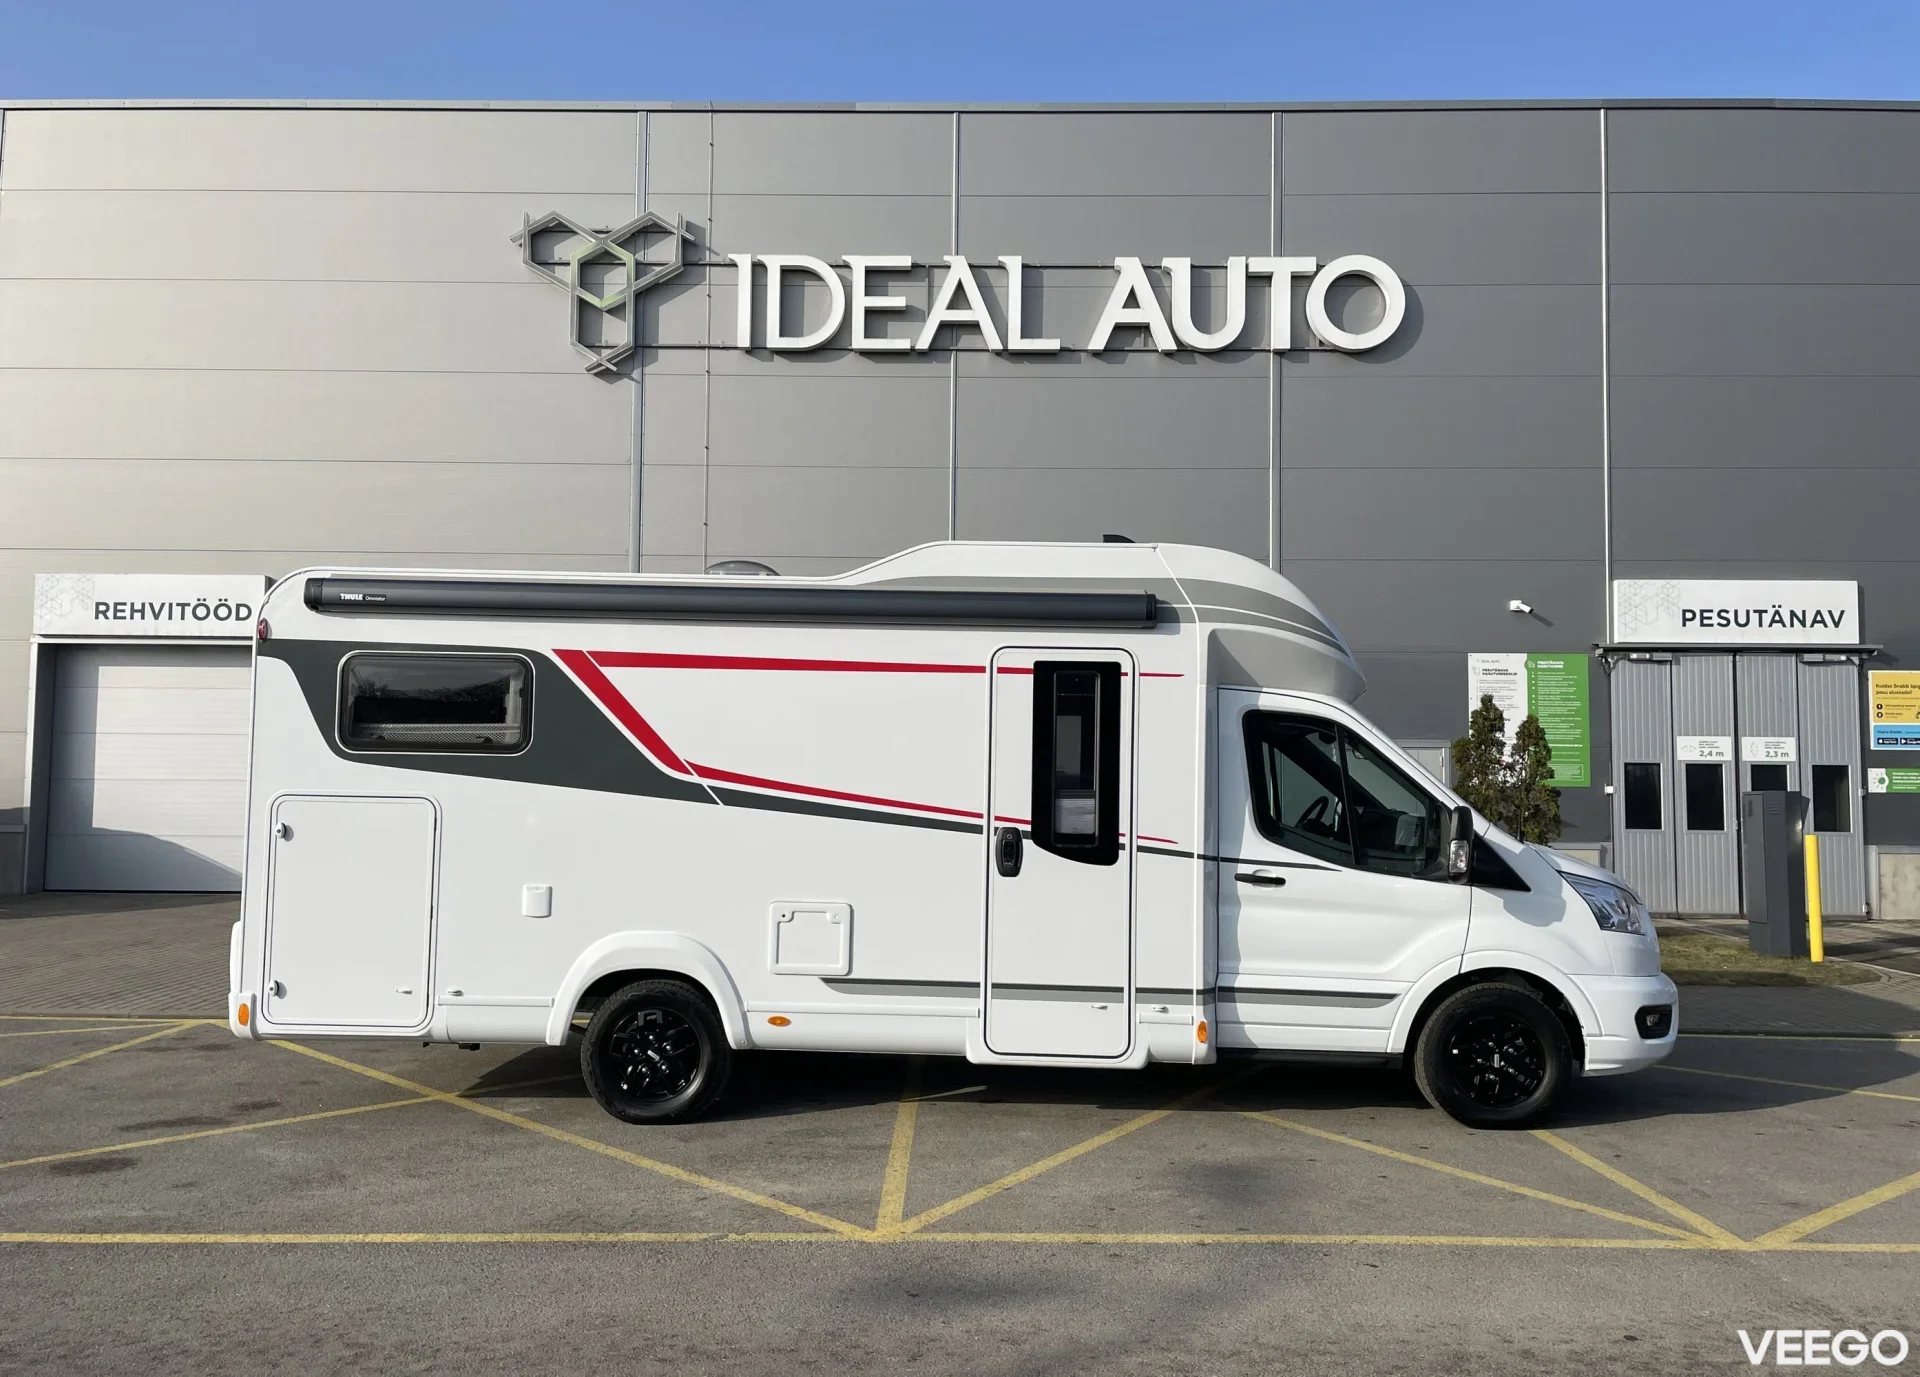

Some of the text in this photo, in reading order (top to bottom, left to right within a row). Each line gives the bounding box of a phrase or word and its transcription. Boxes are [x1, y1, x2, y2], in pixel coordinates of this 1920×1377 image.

[728, 253, 1406, 353] IDEAL AUTO
[94, 598, 252, 621] REHVITÖÖD
[1681, 604, 1846, 628] PESUTÄNAV
[1699, 750, 1713, 758] 2,4
[1765, 751, 1778, 759] 2,3
